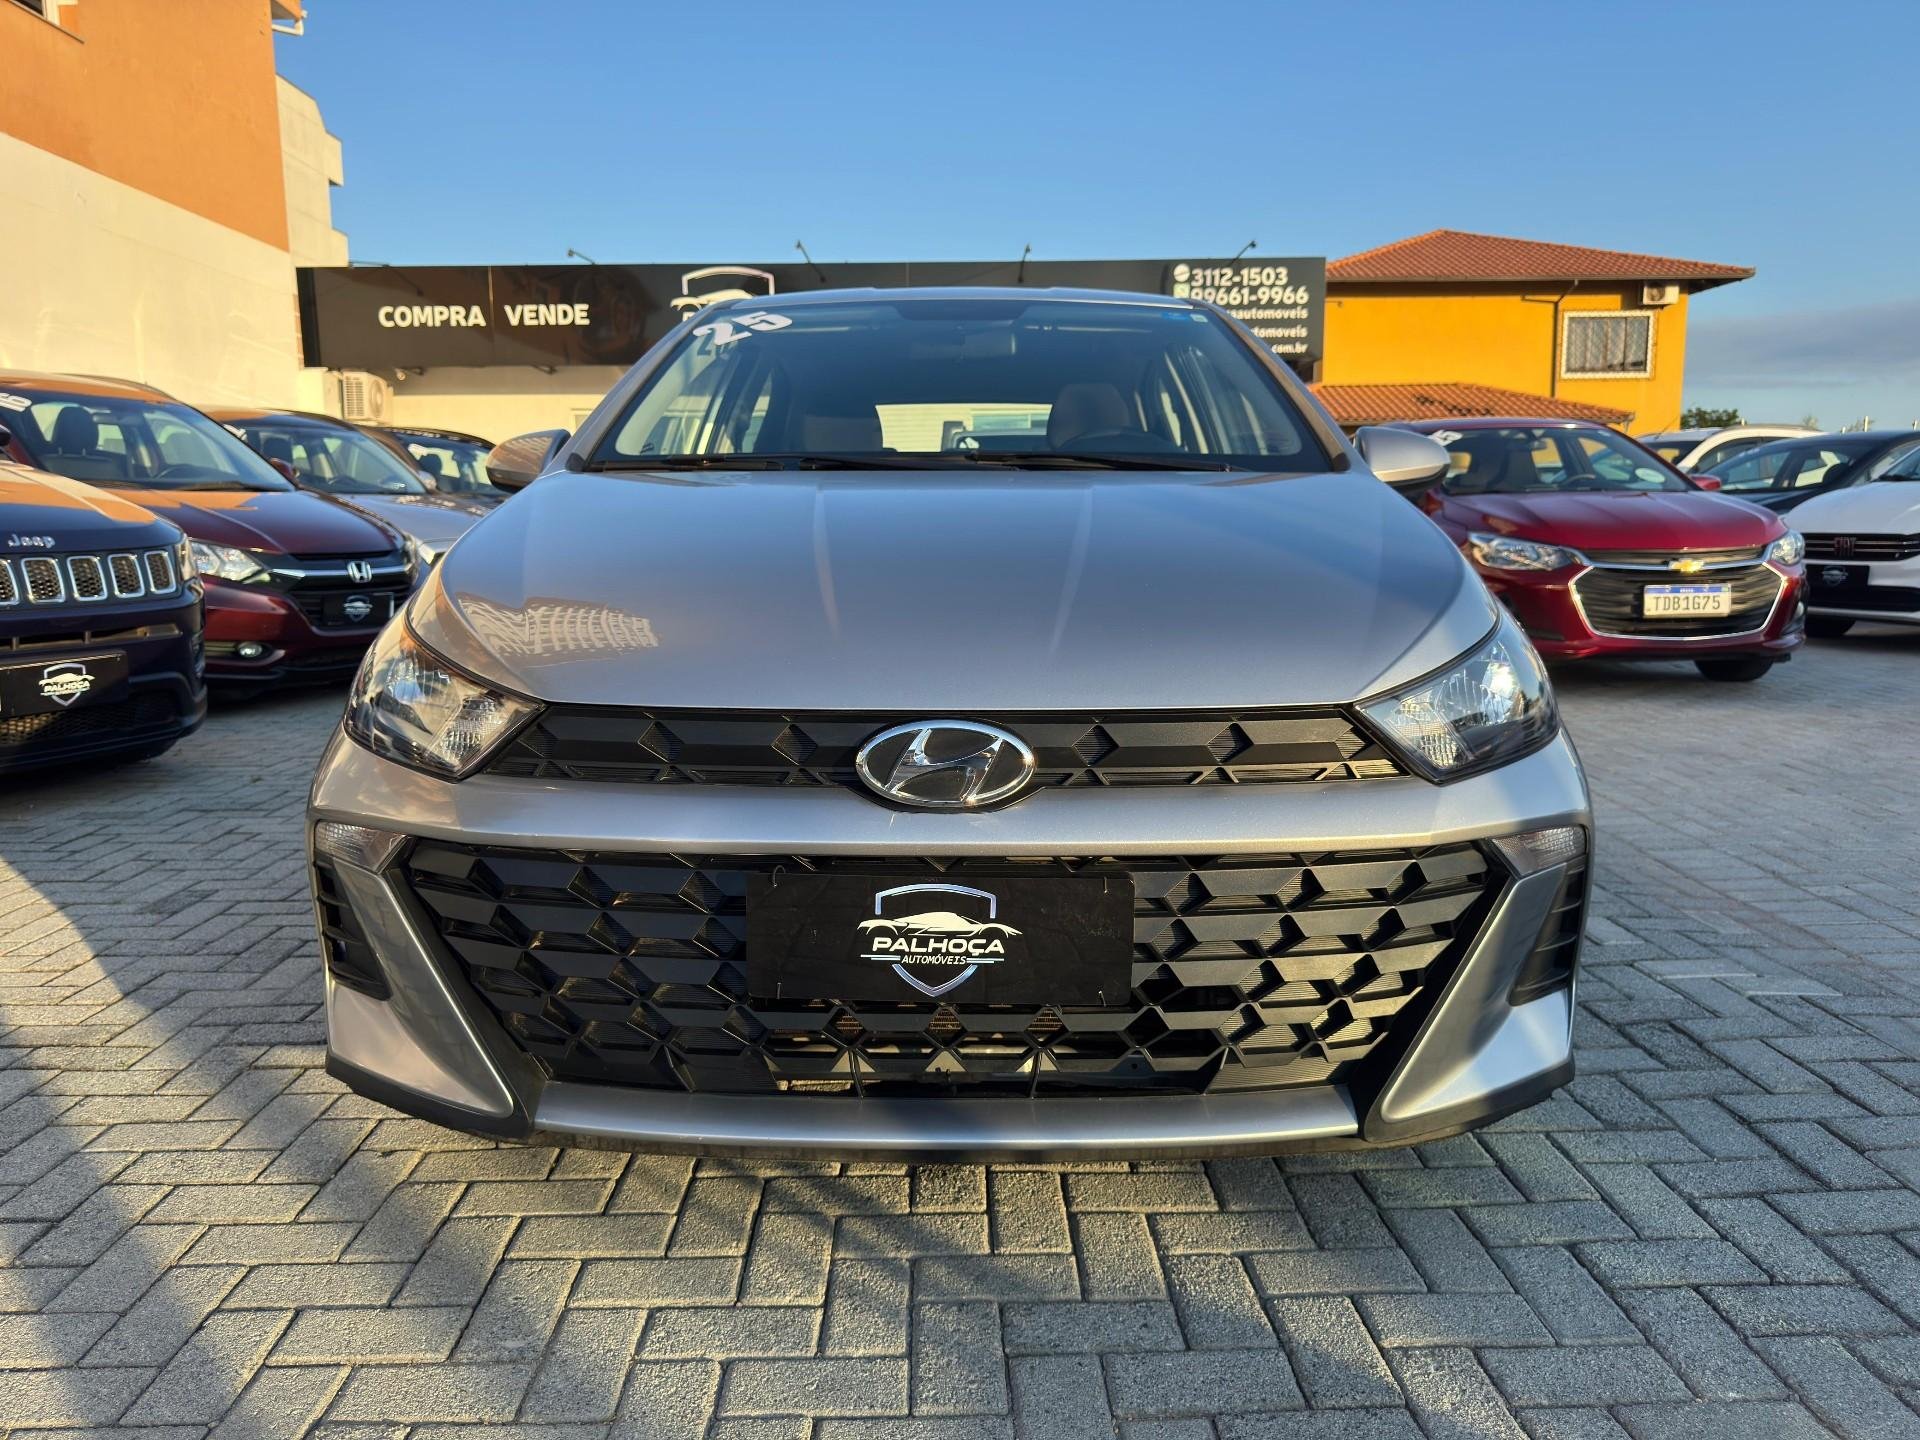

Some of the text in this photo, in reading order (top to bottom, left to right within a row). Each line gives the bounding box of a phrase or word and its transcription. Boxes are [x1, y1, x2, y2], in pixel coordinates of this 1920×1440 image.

[1192, 267, 1288, 286] 3112-1503
[1191, 287, 1309, 305] 99661-9966
[378, 303, 590, 327] COMPRA VENDE
[692, 311, 793, 345] 25
[8, 533, 56, 549] Jeep
[1654, 595, 1721, 611] TDB1G75
[872, 938, 1005, 956] PALHOÇA
[901, 954, 967, 965] AUTOMÓVEIS
